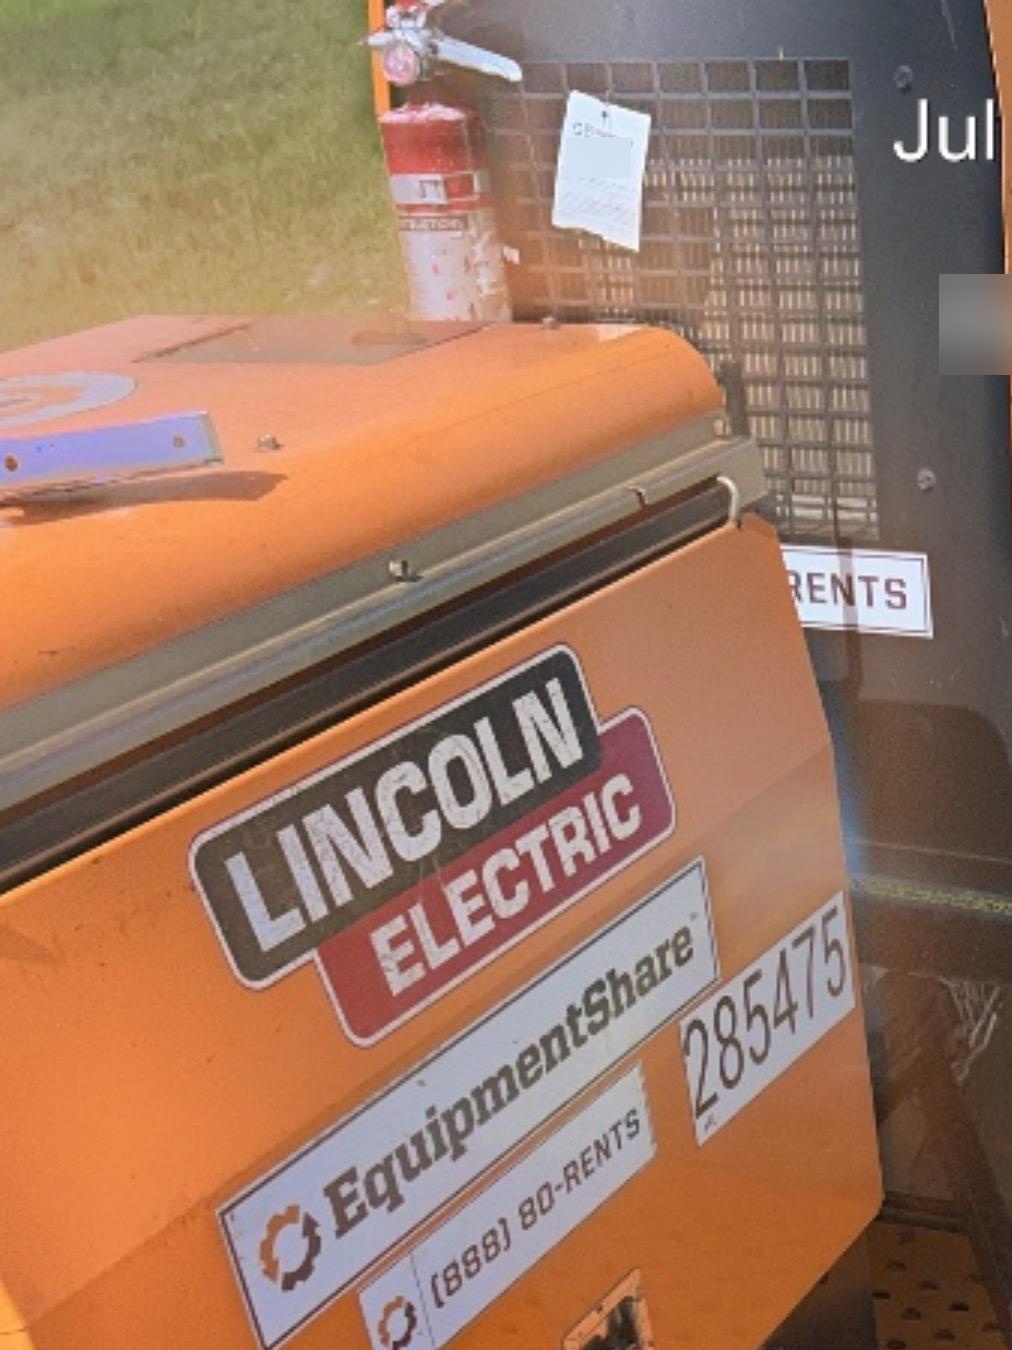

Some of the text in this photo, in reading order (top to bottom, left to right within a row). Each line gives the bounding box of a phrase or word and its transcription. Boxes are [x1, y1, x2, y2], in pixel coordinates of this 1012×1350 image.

[224, 677, 584, 953] LINCOLN
[370, 773, 642, 997] ELECTRIC
[323, 926, 694, 1239] EquipmentShare
[684, 905, 846, 1120] 285475
[430, 1107, 641, 1309] (888) 80-RENTS
